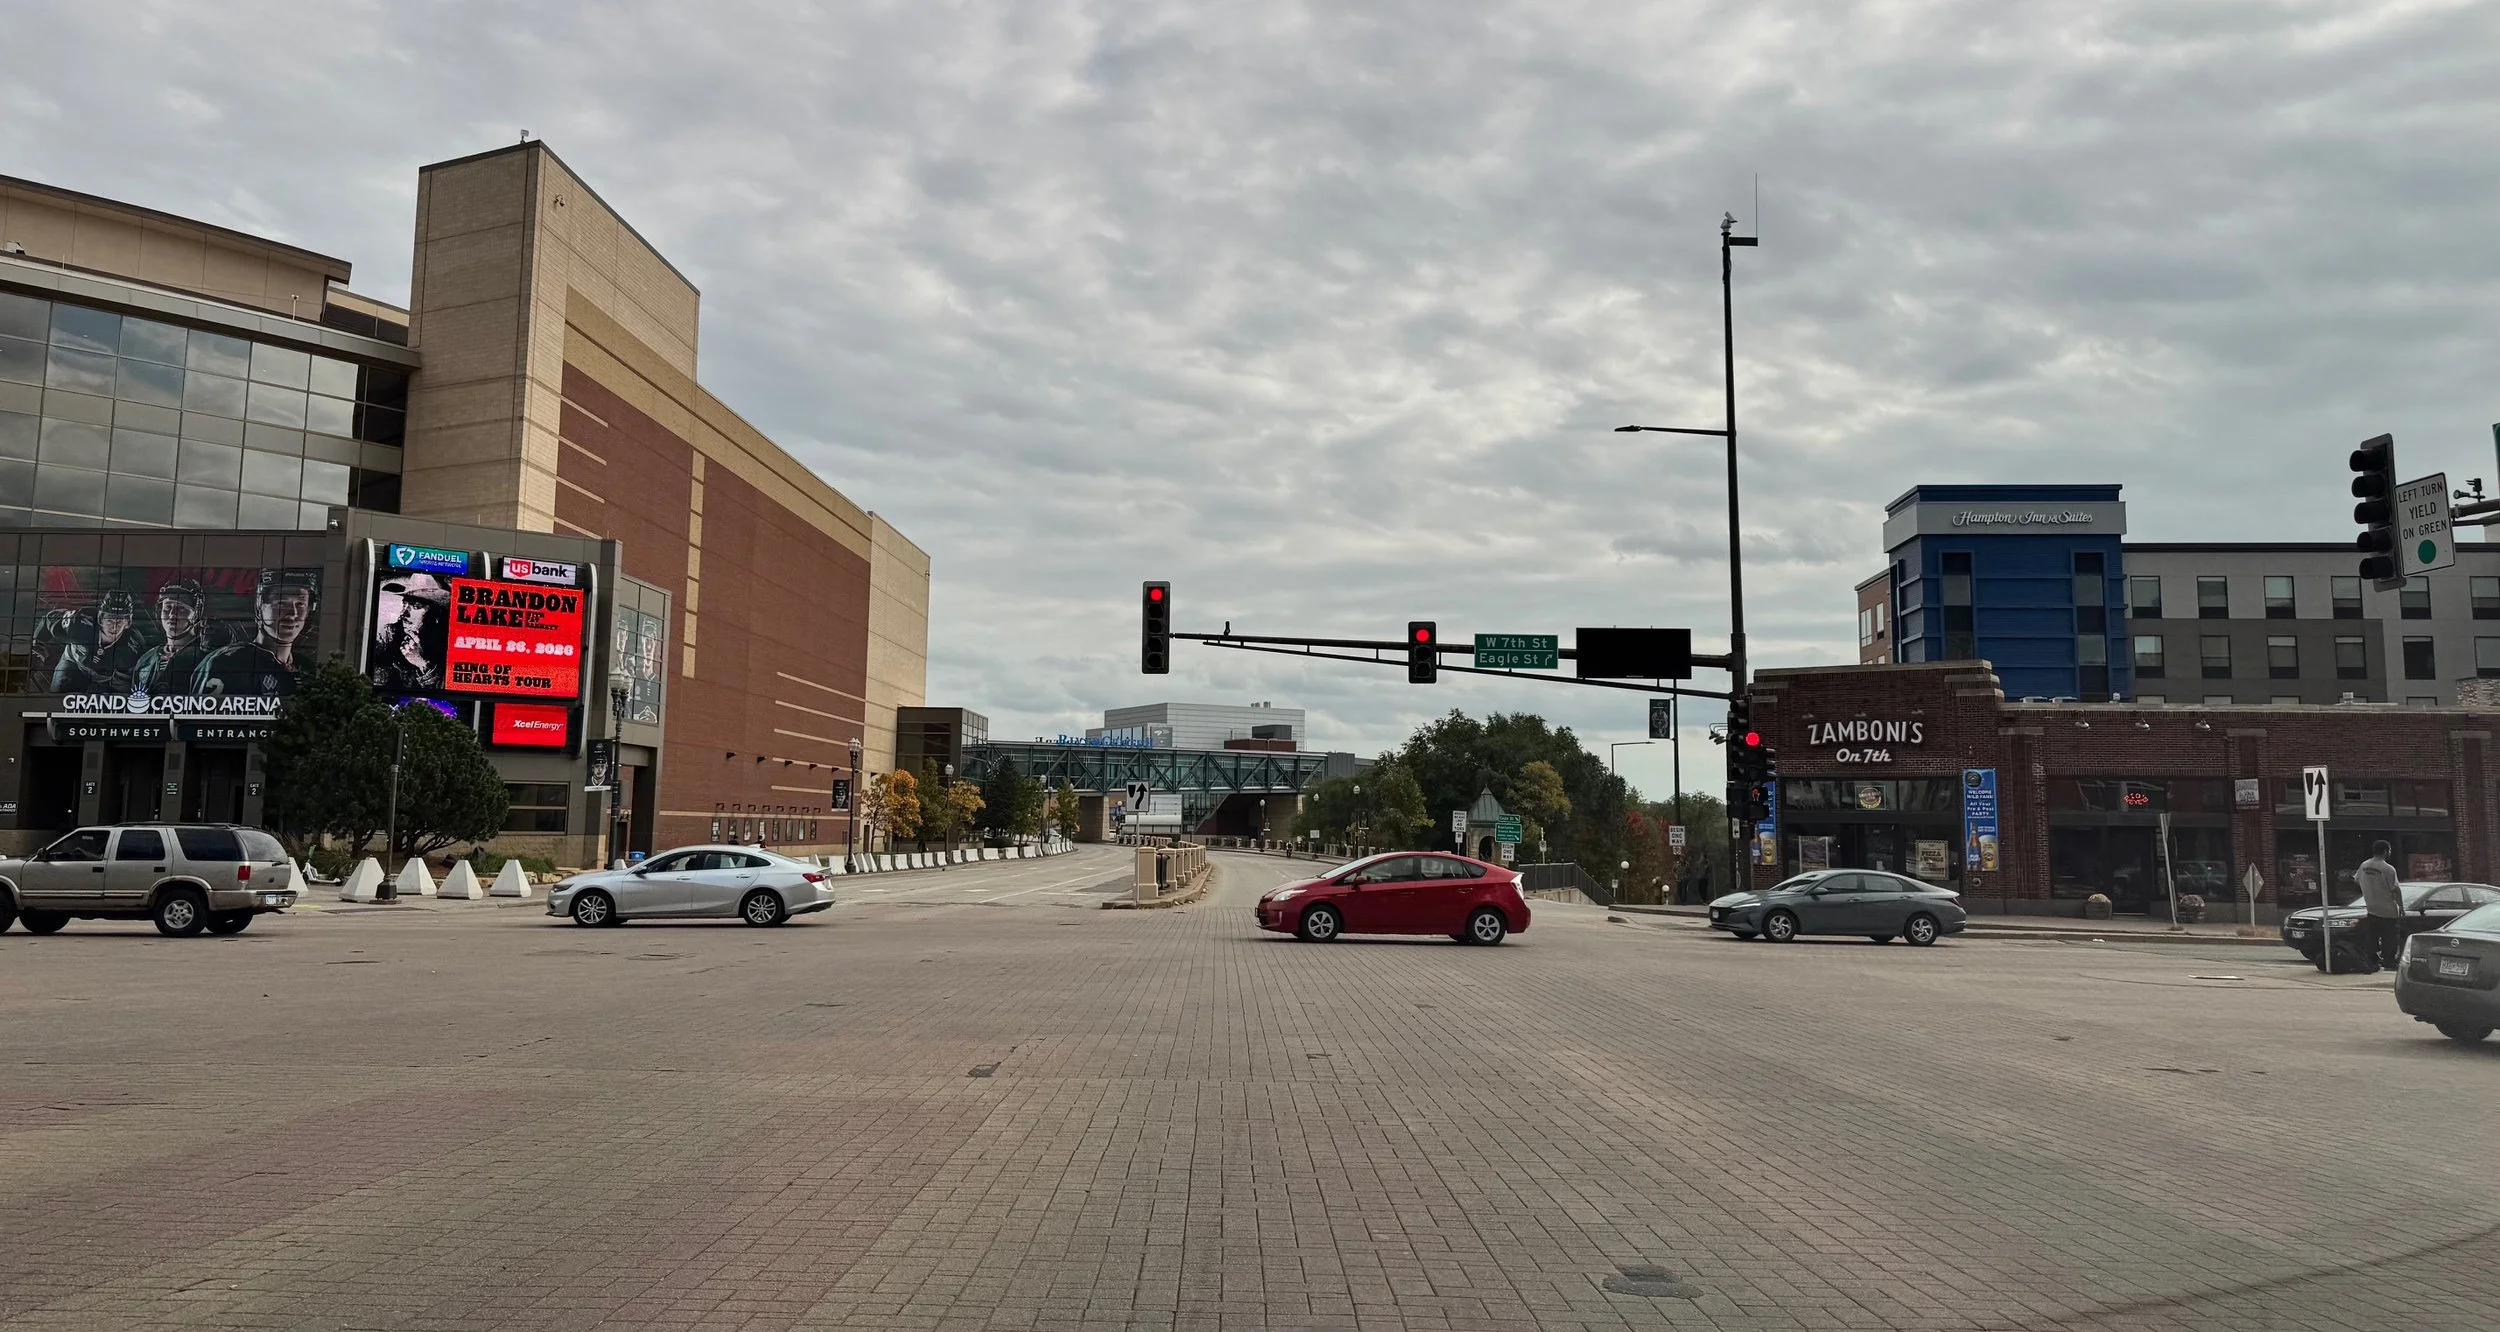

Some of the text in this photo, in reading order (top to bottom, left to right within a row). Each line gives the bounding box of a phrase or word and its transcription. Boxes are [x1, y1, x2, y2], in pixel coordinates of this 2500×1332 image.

[2400, 481, 2444, 502] LEFT TURN
[1952, 511, 2017, 527] Hampton
[2018, 512, 2050, 525] Inn
[2058, 511, 2093, 524] Suites
[2409, 502, 2437, 520] YIELD
[2403, 520, 2448, 540] ON GREEN
[419, 552, 462, 563] FANDUEL
[457, 586, 578, 614] BRANDON
[456, 606, 524, 628] LAKE
[454, 636, 501, 652] APRIL
[534, 644, 574, 656] 2026
[1485, 637, 1548, 649] W 7th St
[1479, 652, 1538, 667] Eagle St
[453, 662, 512, 675] KING OF
[452, 672, 552, 688] HEARTS TOUR
[62, 694, 281, 714] GRAND CASINO ARENA
[69, 728, 161, 738] SOUTHWEST
[1807, 719, 1924, 745] ZAMBONI'S
[1836, 748, 1892, 763] On 7th
[88, 786, 92, 794] 2
